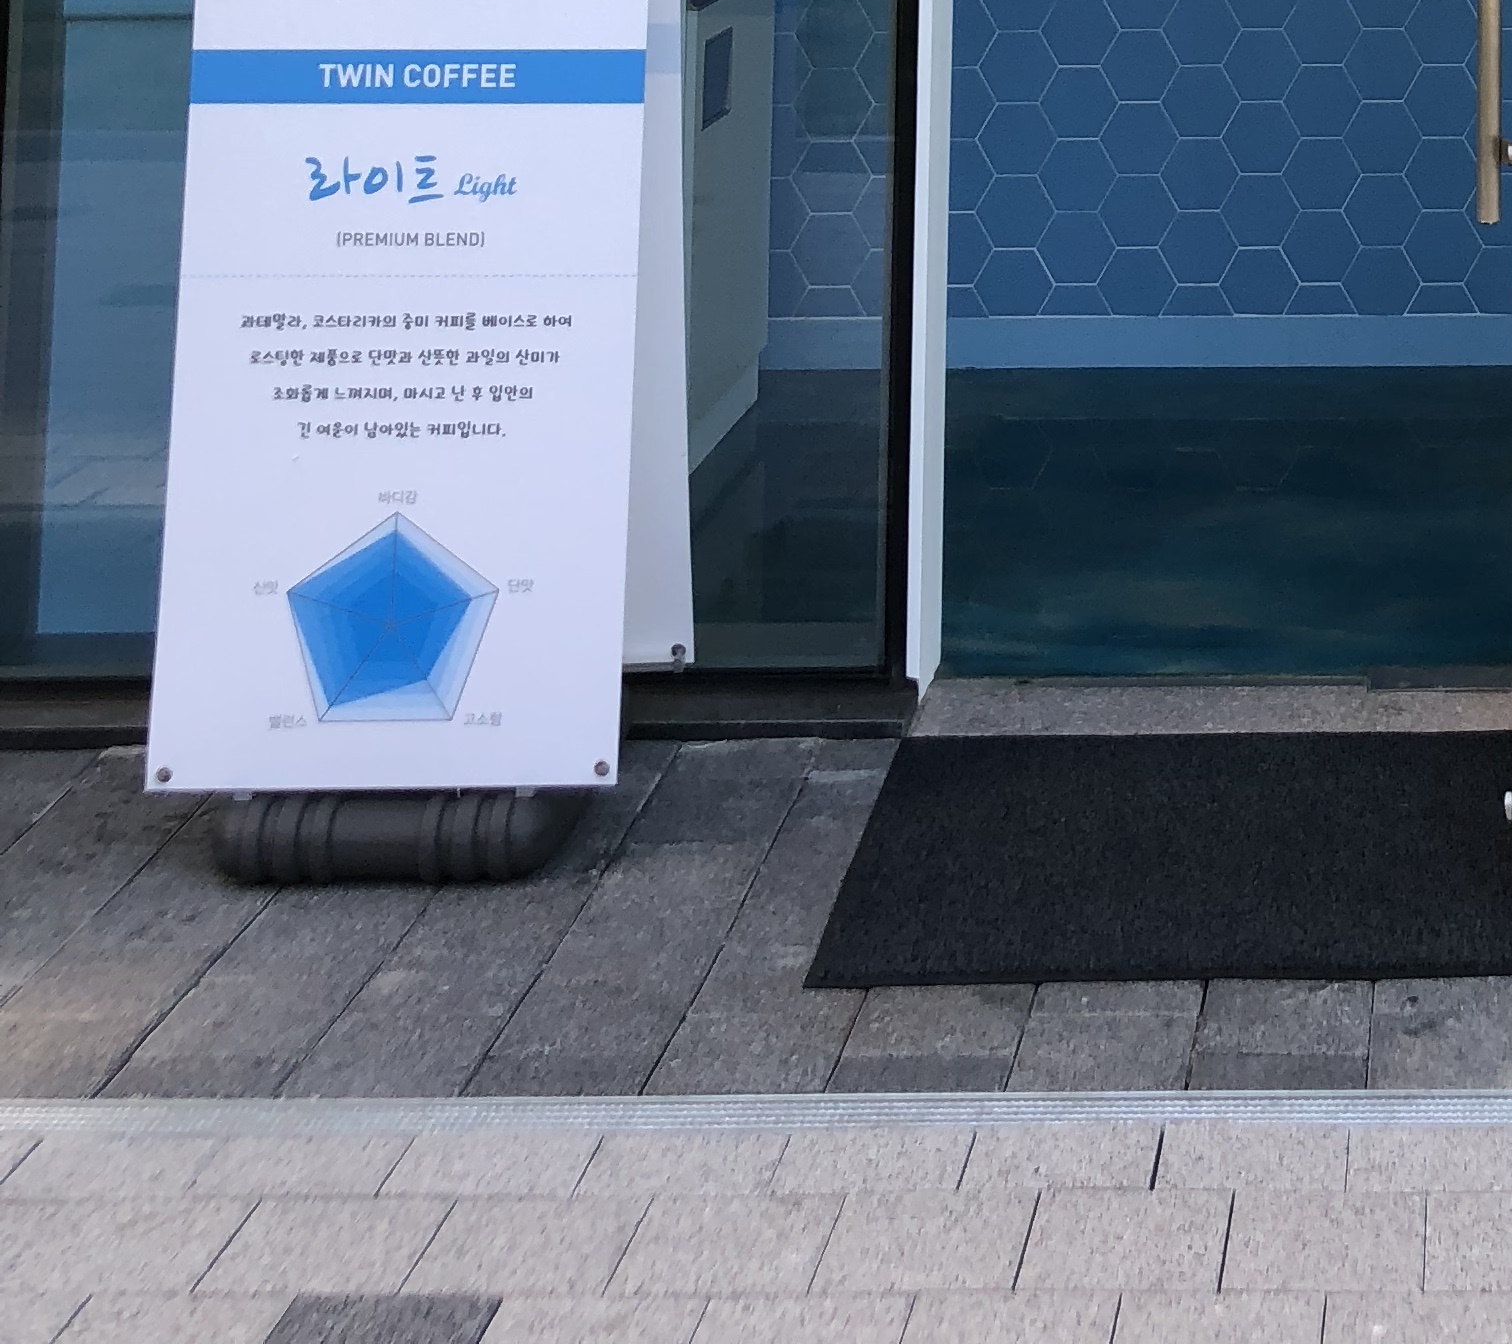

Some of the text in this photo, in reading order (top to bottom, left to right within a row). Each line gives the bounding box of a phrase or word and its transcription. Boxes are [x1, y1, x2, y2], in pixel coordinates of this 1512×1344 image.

[319, 63, 517, 88] TWIN COFFEE
[304, 155, 518, 205] 라이트 Light
[239, 311, 572, 332] 과테말라, 코스타리카의 중미 커피를 베이스로 하여
[250, 348, 561, 367] 로스팅한 제품으로 단맛과 산뜻한 과일의 산미가
[273, 383, 533, 404] 조화롭게 느껴지며, 마시고 난 후 입안의
[297, 420, 507, 440] 긴 여운이 남아있는 커피입니다.
